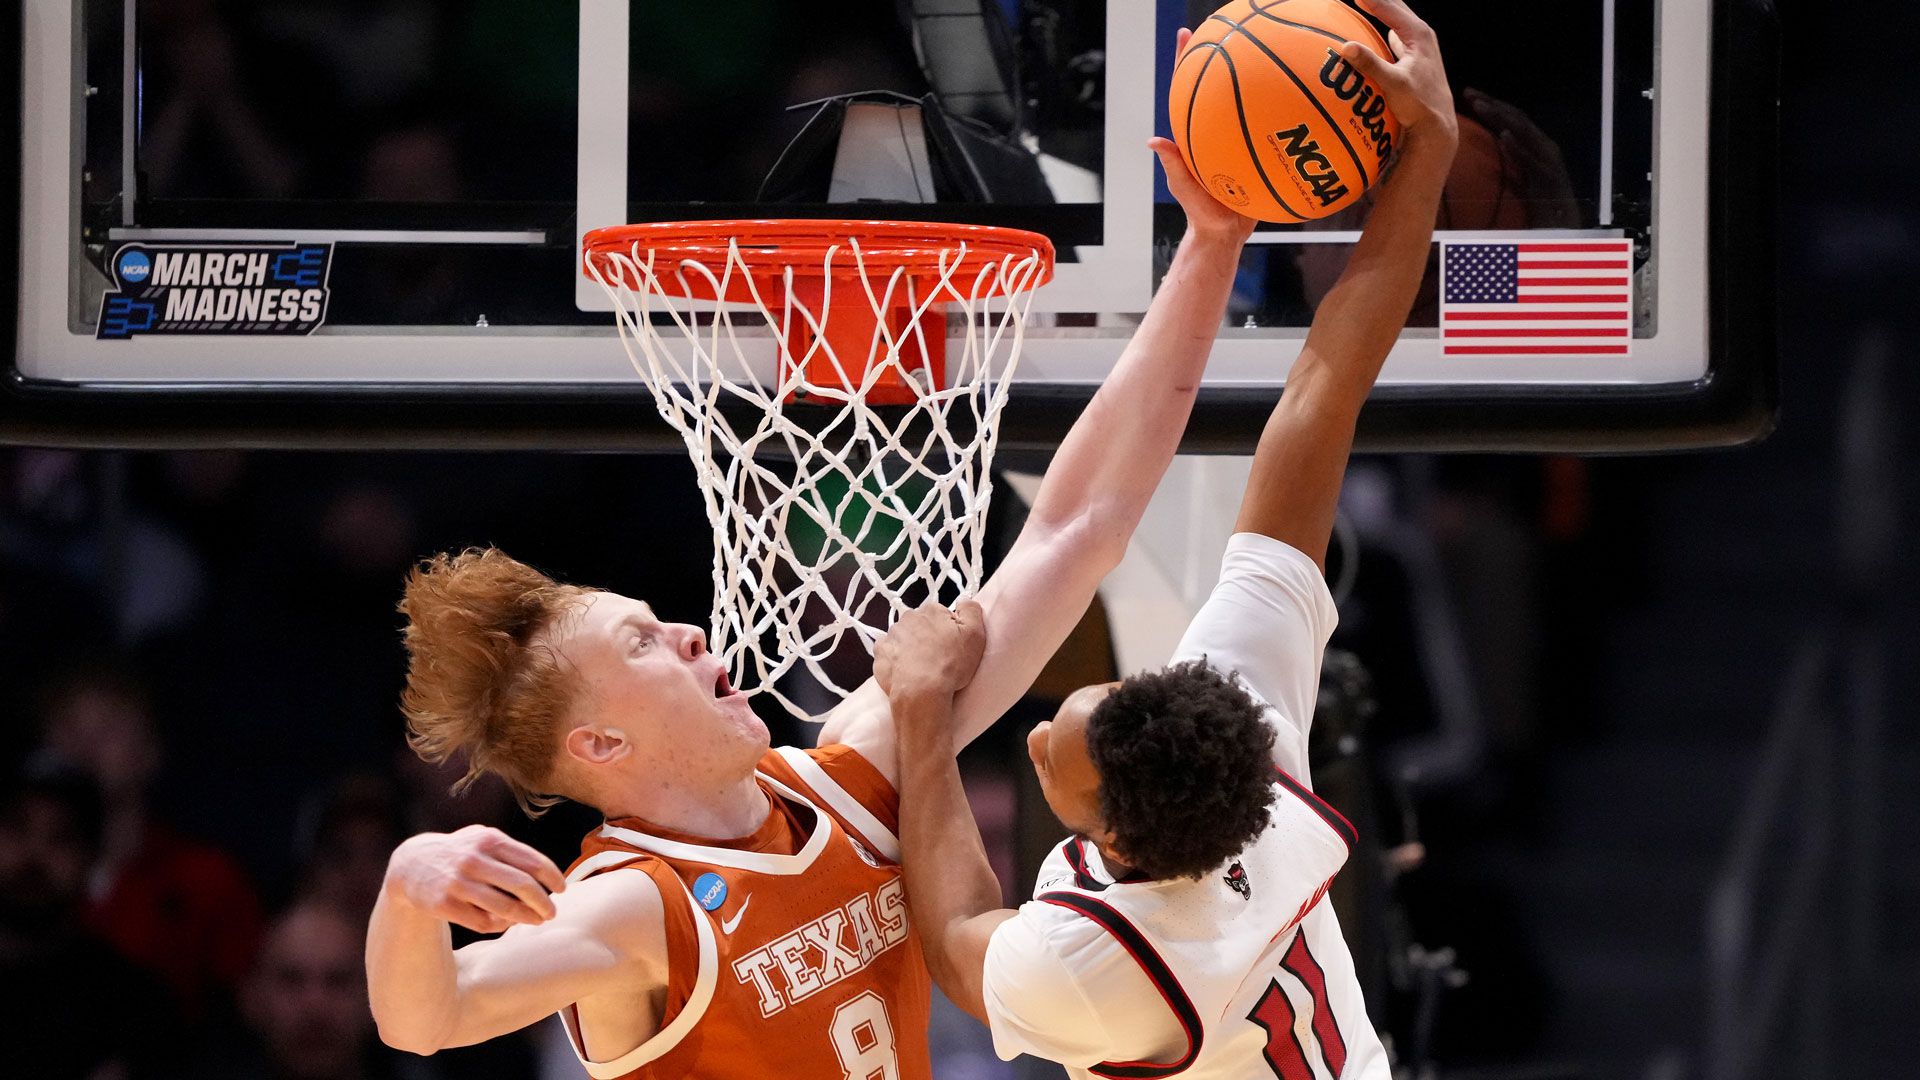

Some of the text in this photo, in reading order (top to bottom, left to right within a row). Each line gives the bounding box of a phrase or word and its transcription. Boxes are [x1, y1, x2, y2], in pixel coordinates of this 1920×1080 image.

[1267, 134, 1290, 174] OFFICIAL
[1275, 123, 1350, 207] NCAA
[122, 264, 149, 275] NCAA
[151, 252, 269, 286] MARCH
[164, 288, 323, 322] MADNESS
[701, 879, 725, 908] NCAA
[731, 875, 909, 1019] TEXAS
[1245, 923, 1347, 1080] 11
